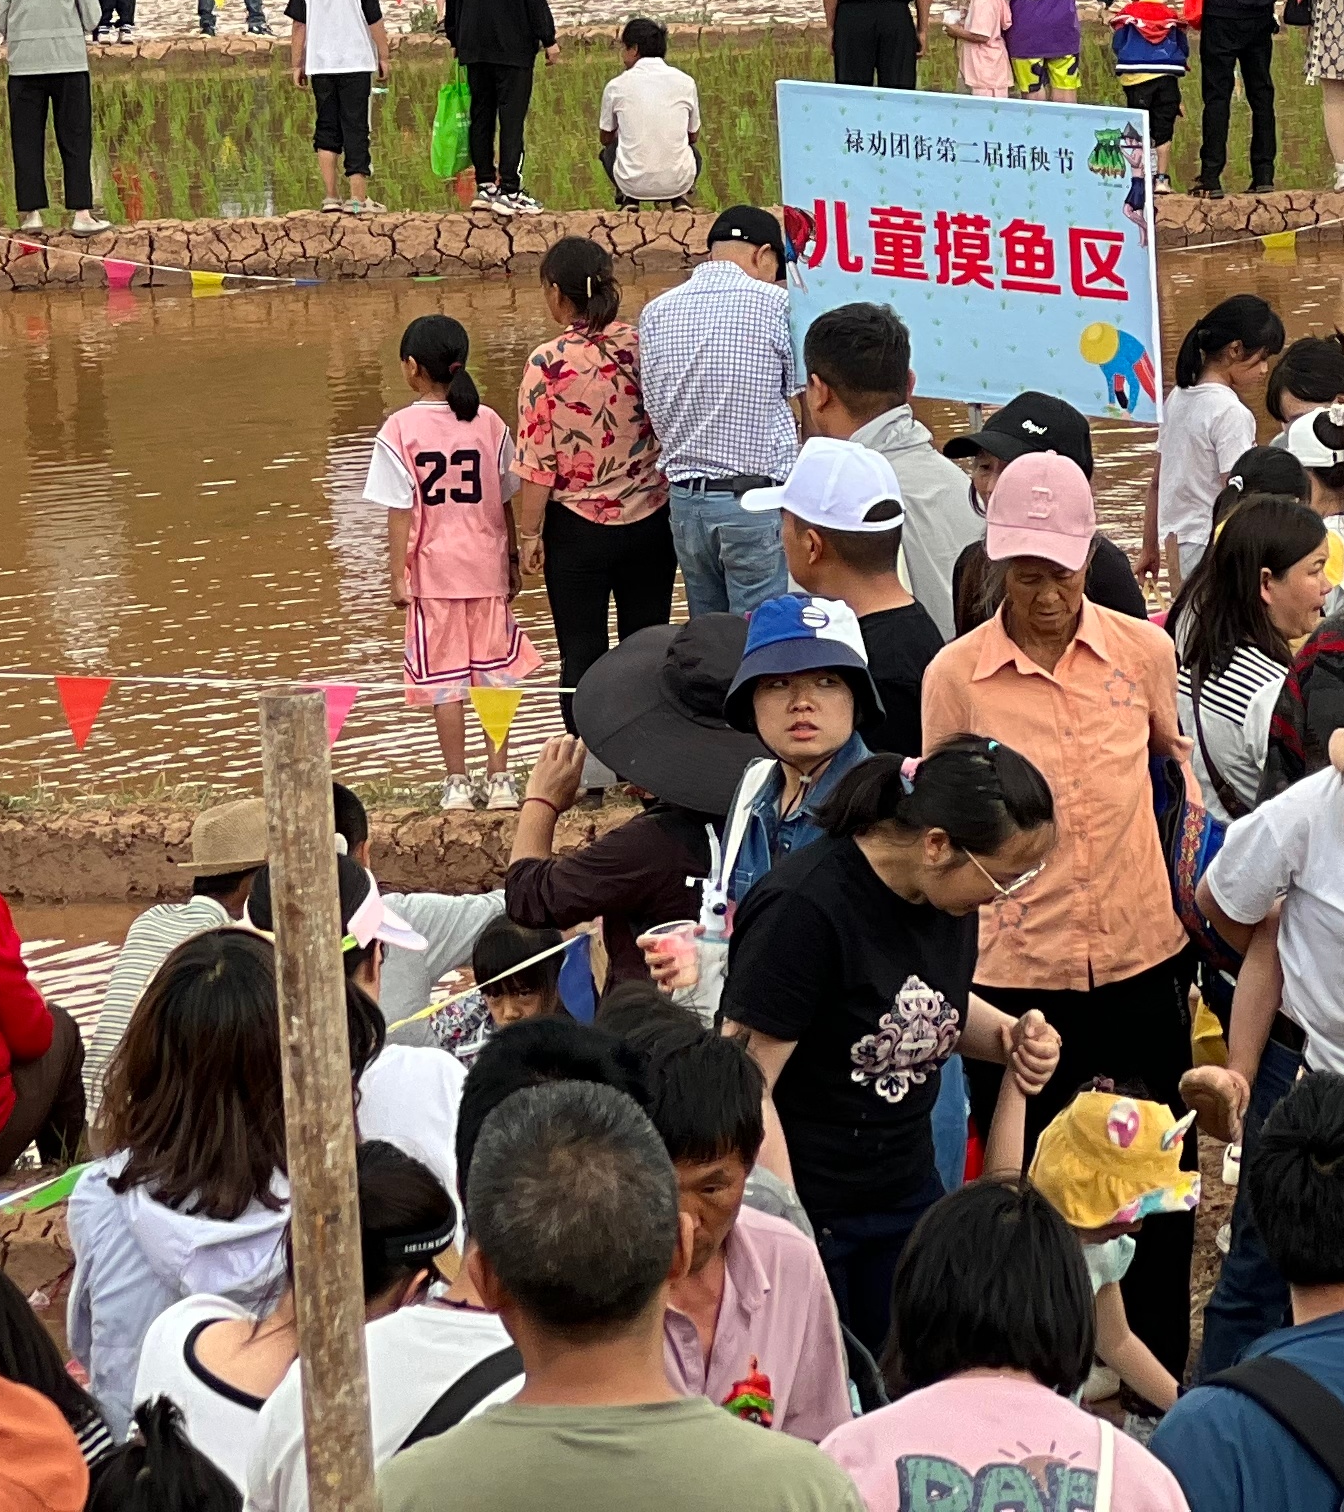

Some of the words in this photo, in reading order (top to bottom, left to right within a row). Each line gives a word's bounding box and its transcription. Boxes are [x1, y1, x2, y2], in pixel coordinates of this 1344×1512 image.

[843, 127, 1075, 174] 禄劝团街第二届插秧节
[807, 198, 1129, 302] 儿童摸鱼区
[415, 449, 483, 507] 23
